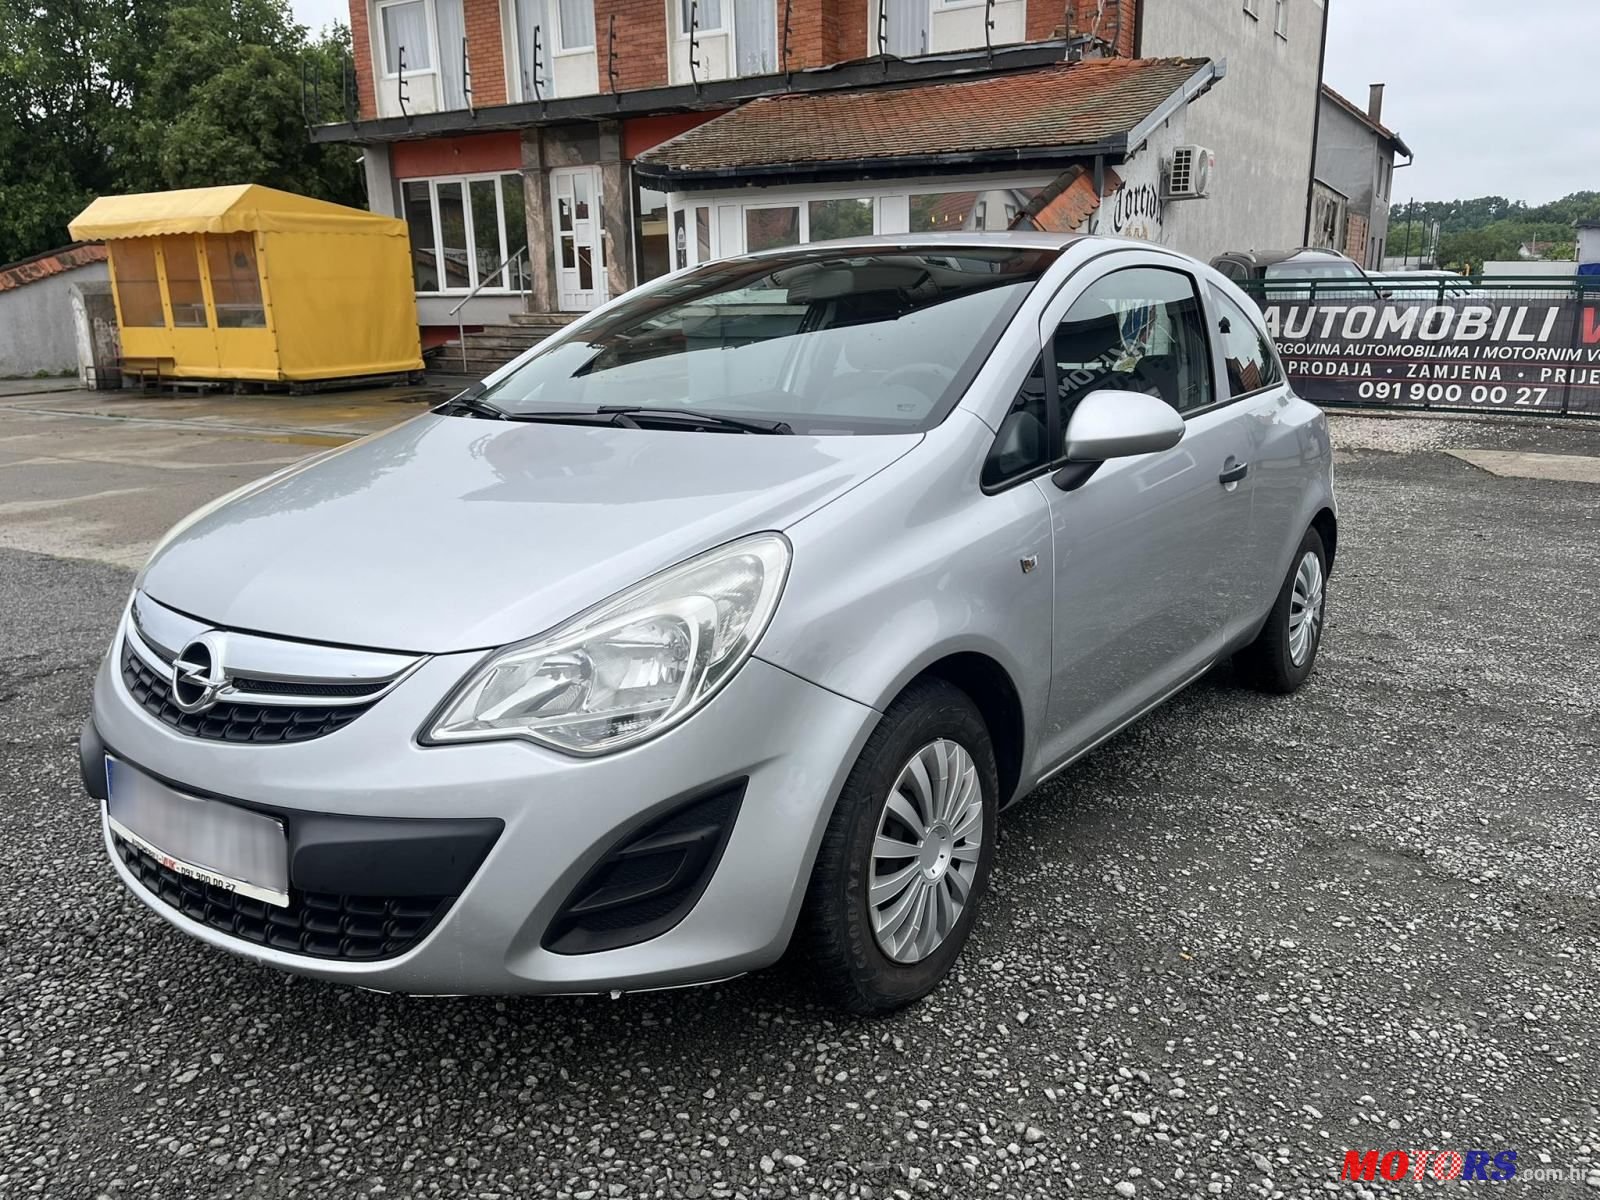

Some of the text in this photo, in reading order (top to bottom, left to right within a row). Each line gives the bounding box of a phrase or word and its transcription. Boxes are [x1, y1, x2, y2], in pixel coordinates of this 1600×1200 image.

[1264, 305, 1560, 342] AUTOMOBILI
[1276, 342, 1342, 356] RGOVINA
[1344, 344, 1469, 358] AUTOMOBILIMA
[1473, 346, 1479, 358] I
[1483, 346, 1582, 361] MOTORNIM
[1288, 360, 1600, 385] PRODAJA ZAMJENA PRIJE
[1358, 381, 1548, 405] 091 900 00 27
